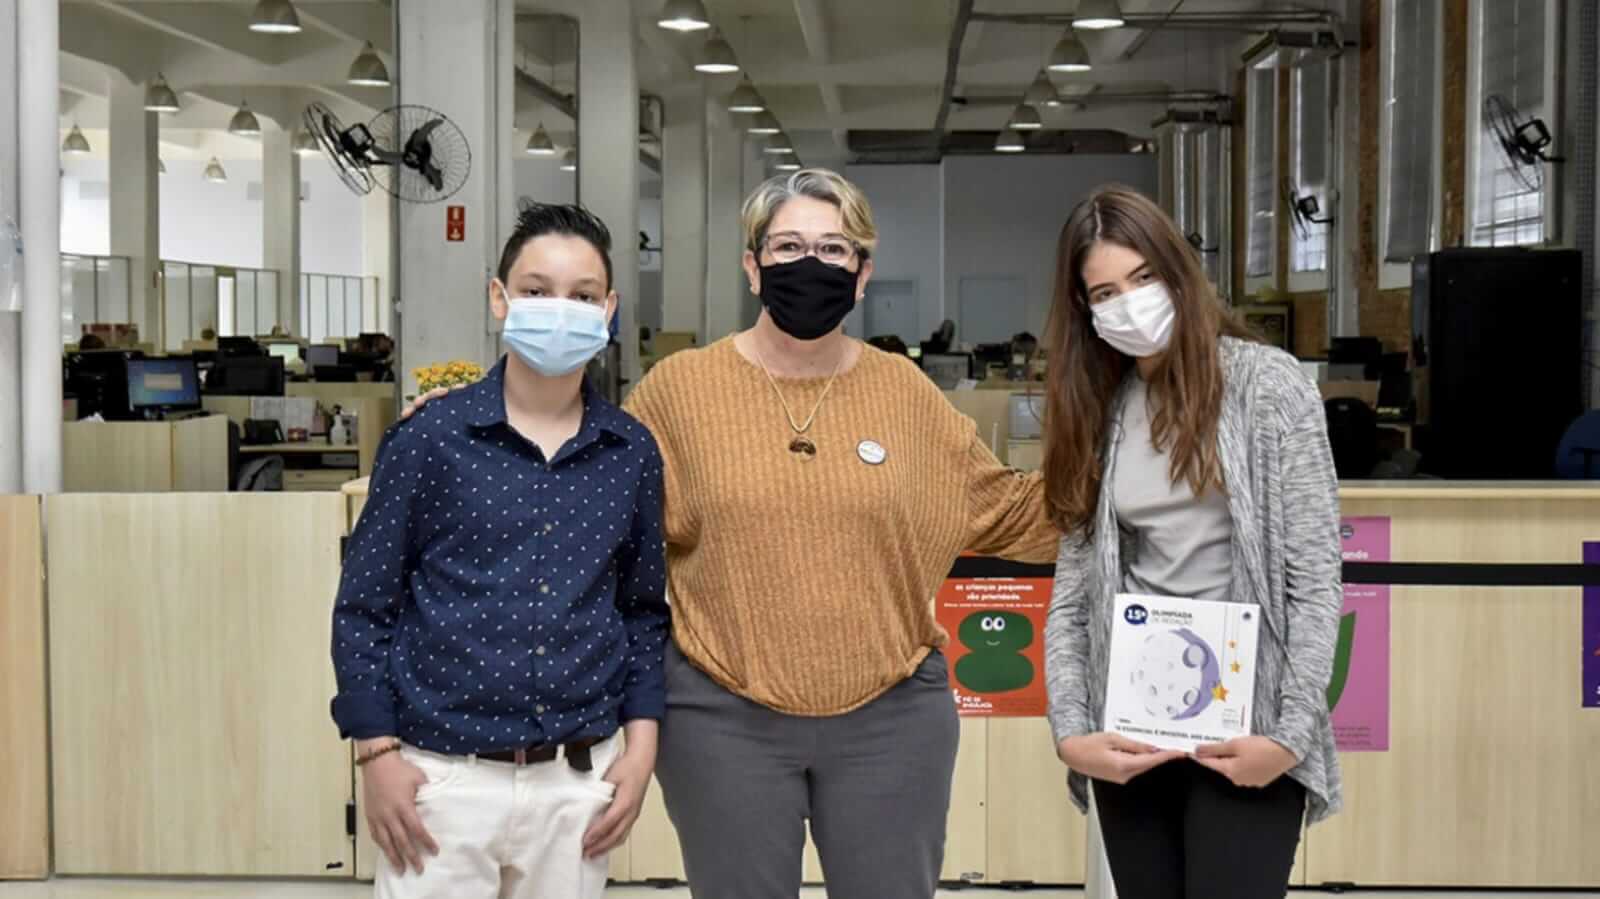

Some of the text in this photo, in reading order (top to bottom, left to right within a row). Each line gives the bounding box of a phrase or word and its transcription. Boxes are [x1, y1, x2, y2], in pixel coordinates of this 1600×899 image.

[1341, 548, 1369, 560] ando
[965, 583, 996, 593] crianças
[998, 584, 1034, 593] pequenas
[967, 592, 980, 601] são
